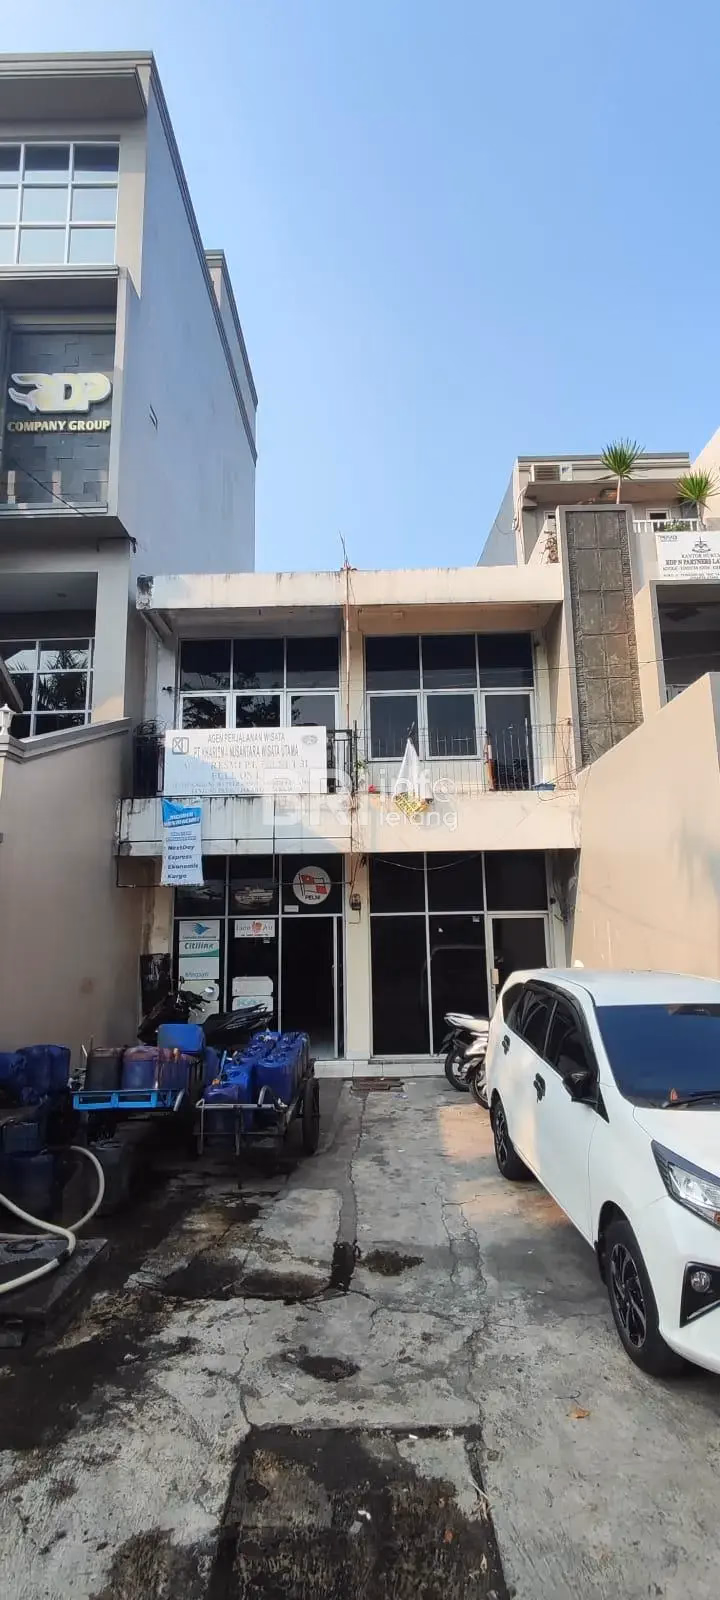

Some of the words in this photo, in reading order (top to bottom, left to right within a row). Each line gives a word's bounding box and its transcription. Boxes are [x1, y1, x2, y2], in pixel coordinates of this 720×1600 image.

[7, 420, 66, 432] COMPANY
[68, 419, 111, 431] GROUP
[207, 734, 223, 744] AGEN
[224, 732, 263, 743] PERJALANAN
[263, 732, 286, 742] WISATA
[230, 745, 261, 758] NUSANTARA
[262, 744, 280, 757] WISATA
[281, 743, 300, 757] UTAMA
[184, 941, 214, 950] Citilink
